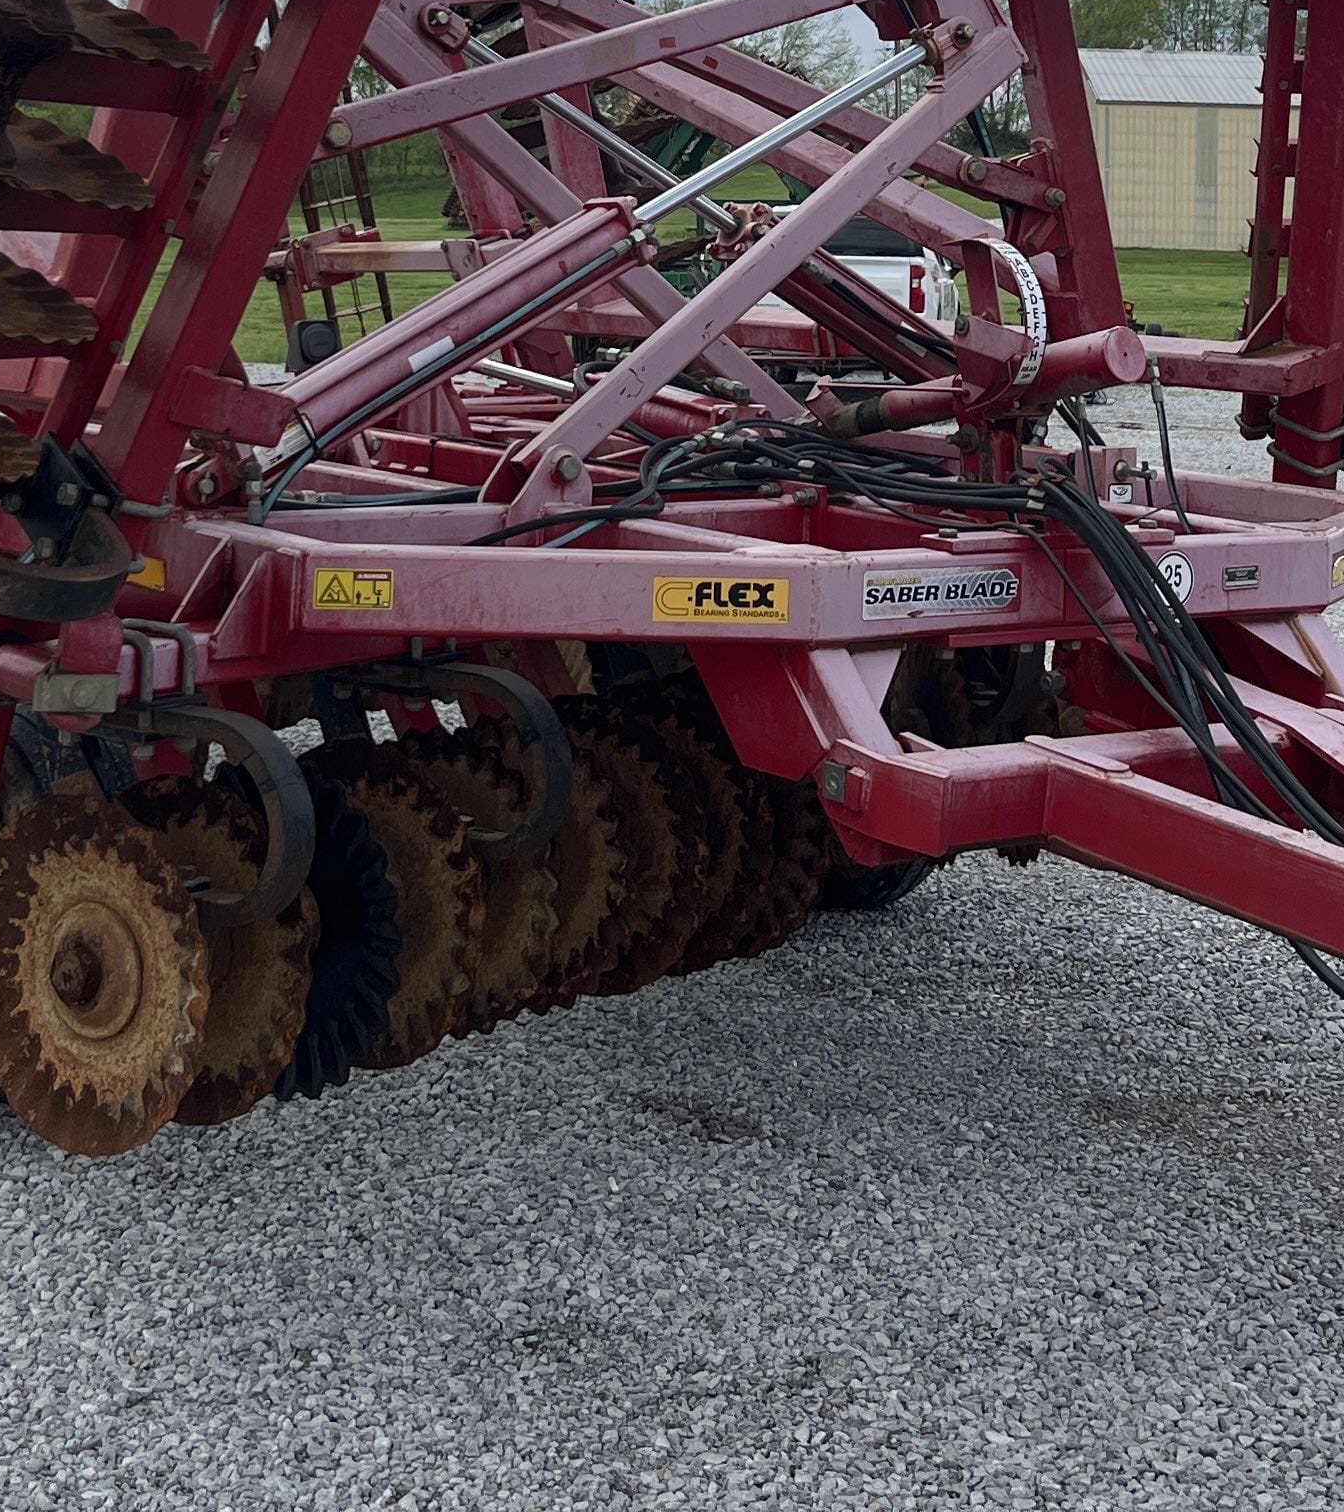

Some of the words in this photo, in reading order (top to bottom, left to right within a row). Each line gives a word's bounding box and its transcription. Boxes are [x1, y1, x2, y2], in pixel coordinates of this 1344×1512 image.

[1020, 268, 1030, 278] B
[1027, 281, 1034, 291] C
[1030, 294, 1038, 305] D
[1033, 308, 1040, 318] E
[1034, 322, 1041, 332] F
[1032, 335, 1040, 347] G
[1029, 350, 1037, 361] H
[1164, 564, 1182, 587] 25
[864, 585, 940, 605] SABER
[945, 580, 1019, 600] BLADE
